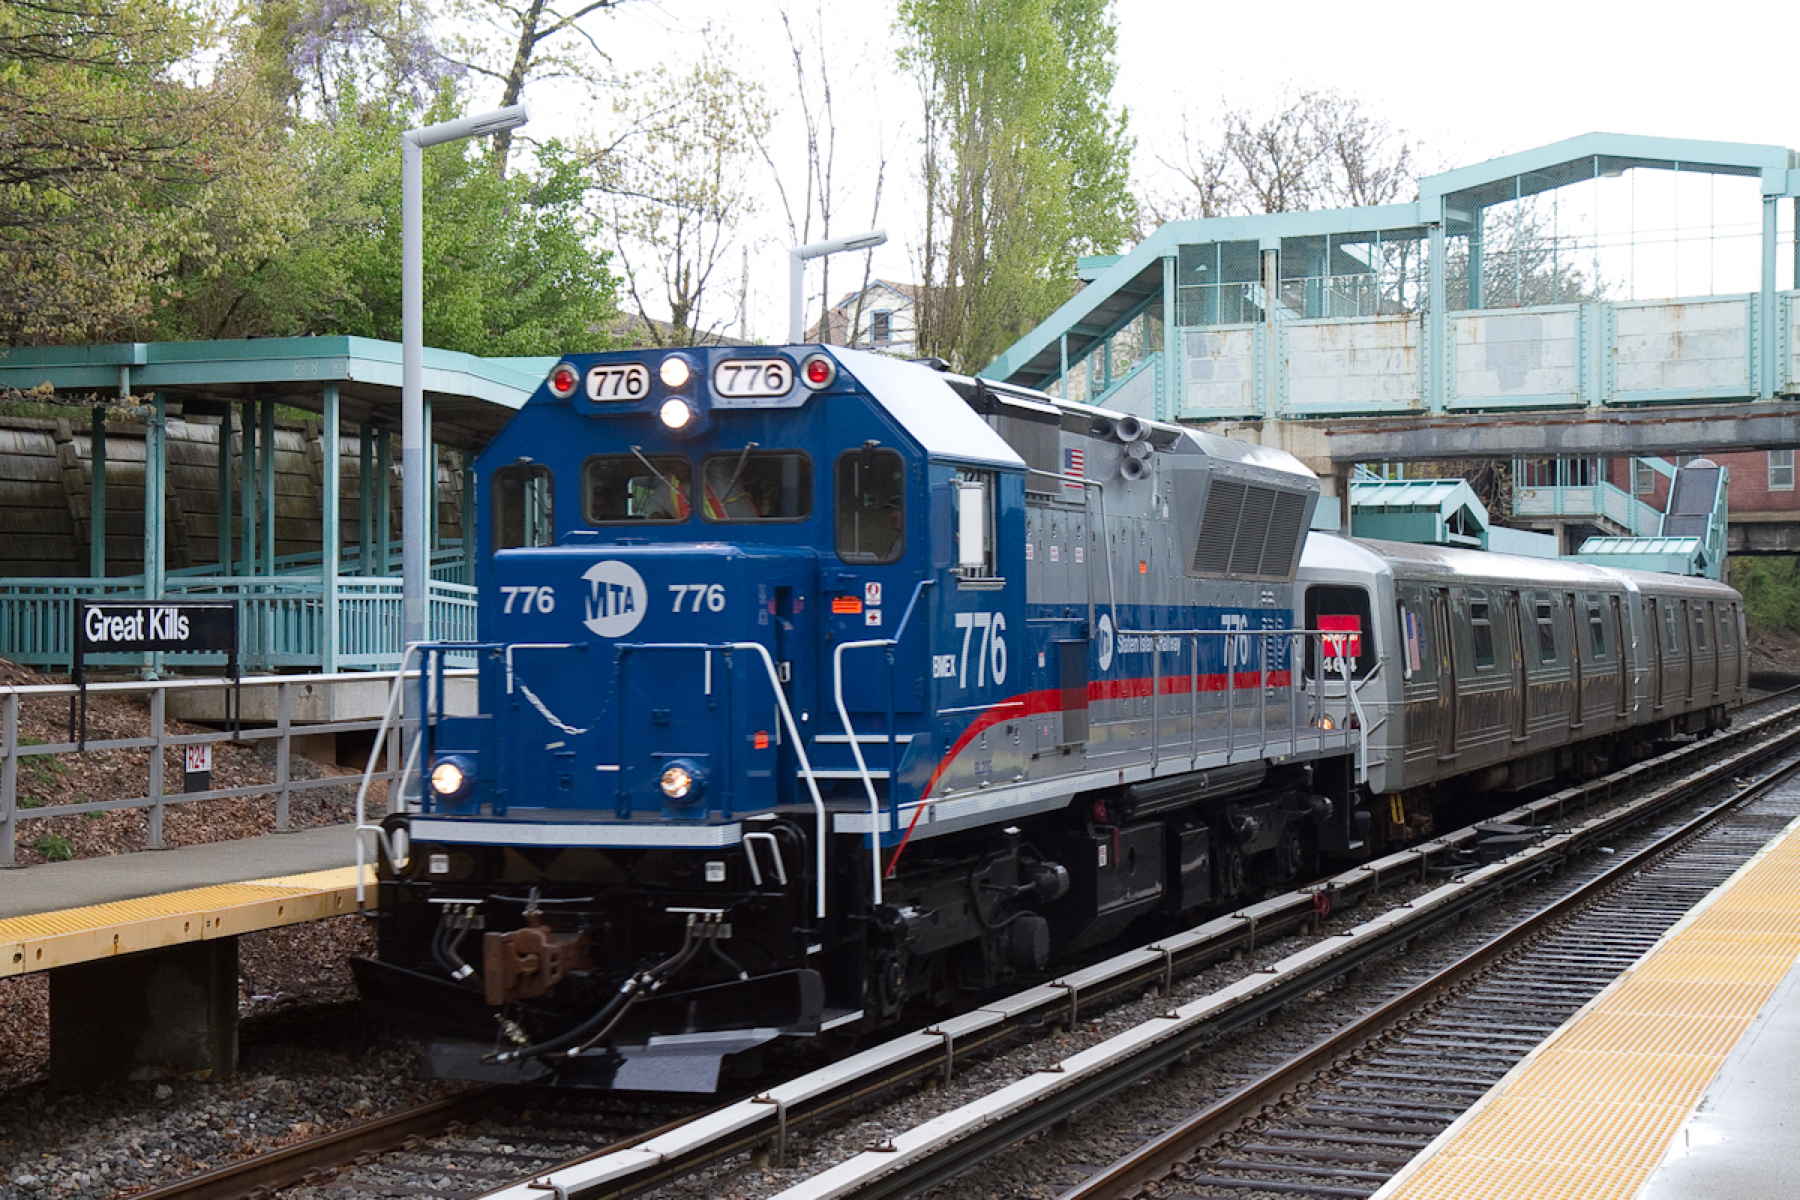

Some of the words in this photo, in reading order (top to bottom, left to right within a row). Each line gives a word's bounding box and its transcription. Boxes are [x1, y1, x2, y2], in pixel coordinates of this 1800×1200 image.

[593, 368, 643, 397] 776
[723, 363, 784, 392] 776
[500, 585, 555, 614] 776
[668, 584, 726, 613] 776
[85, 607, 144, 642] Great
[149, 607, 190, 641] Kills
[955, 611, 1007, 688] 776
[1221, 614, 1248, 667] 776
